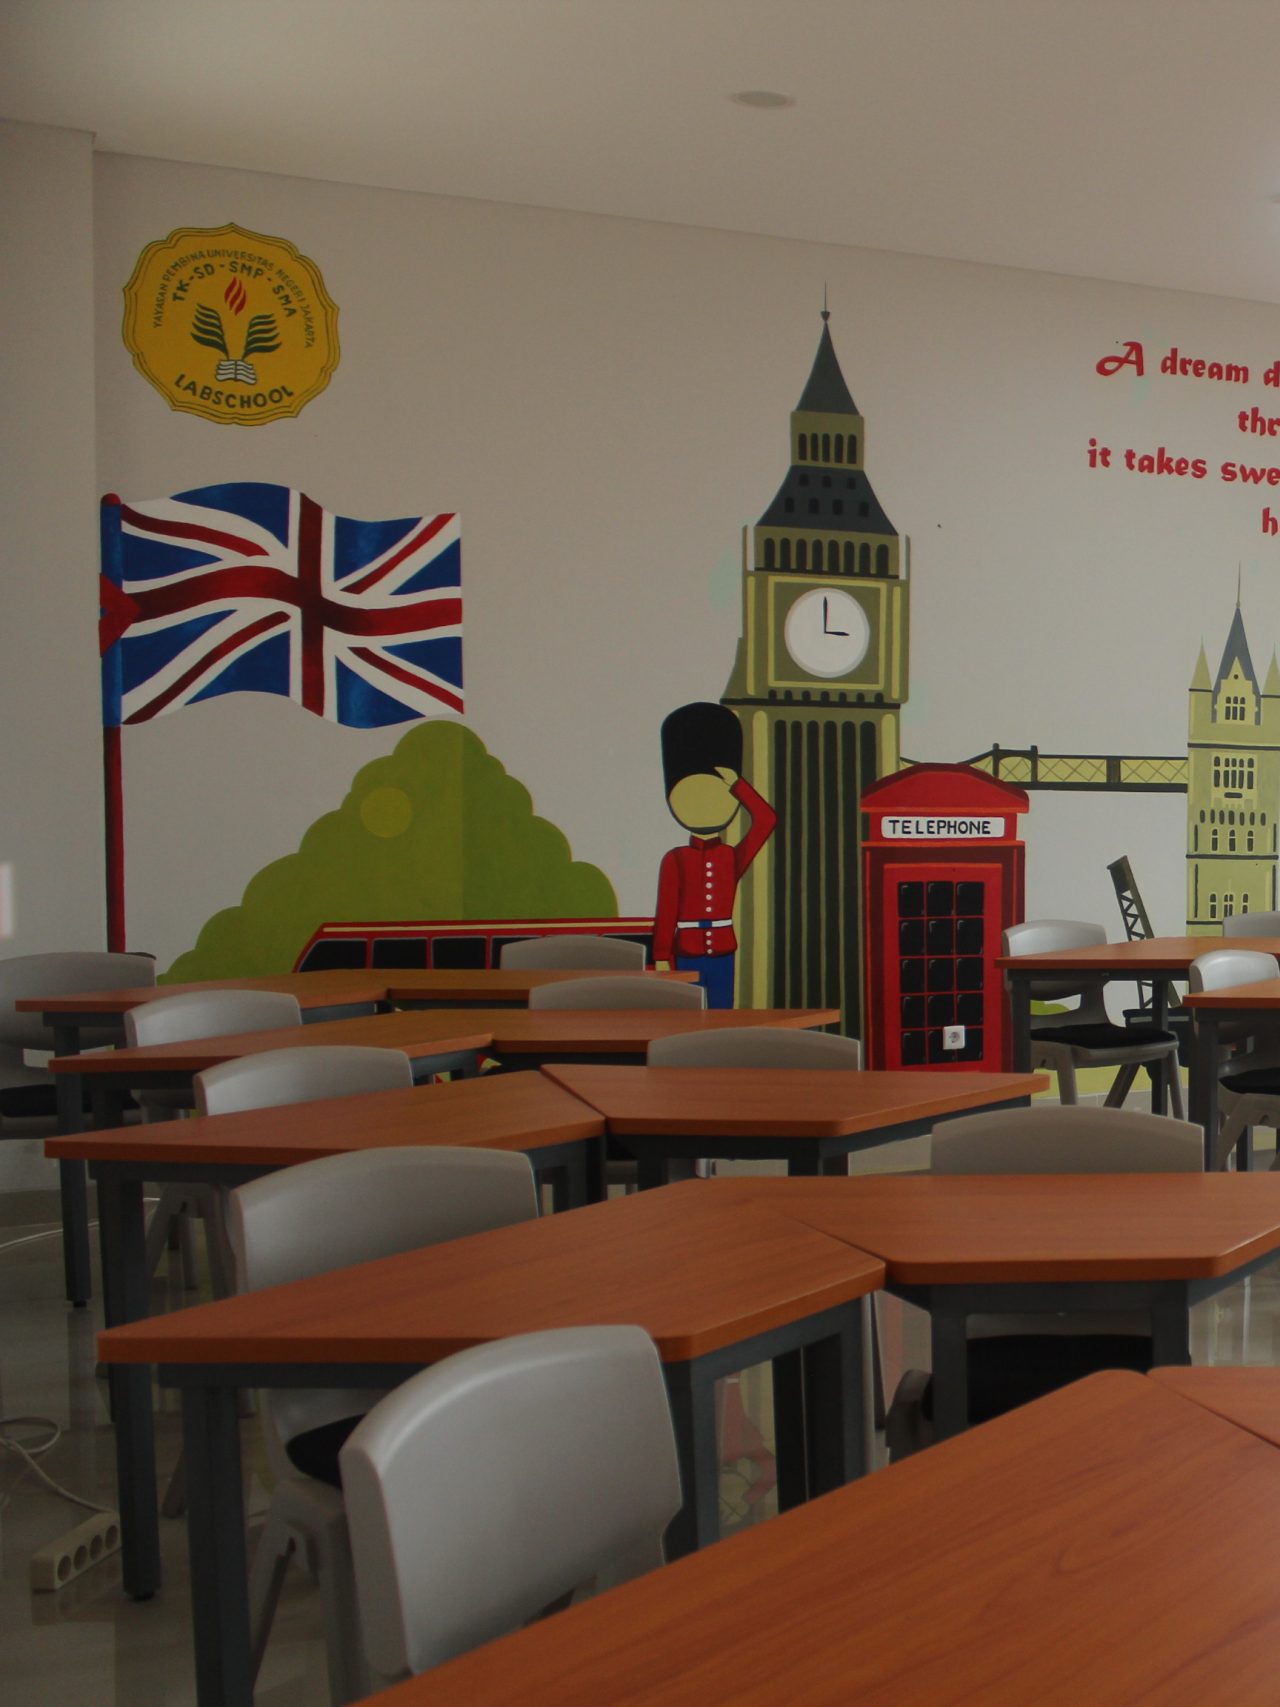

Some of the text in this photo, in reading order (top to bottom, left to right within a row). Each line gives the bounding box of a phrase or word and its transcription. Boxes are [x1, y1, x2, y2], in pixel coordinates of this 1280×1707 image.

[153, 248, 316, 349] YAYASAN PEMBINA UNIVERSITAS NEGERI JAKARTA
[1096, 341, 1144, 376] A
[1161, 348, 1249, 384] dream
[174, 373, 295, 409] LABSCHOOL
[1087, 438, 1111, 468] it
[1124, 446, 1207, 479] takes
[889, 820, 991, 835] TELEPHONE
